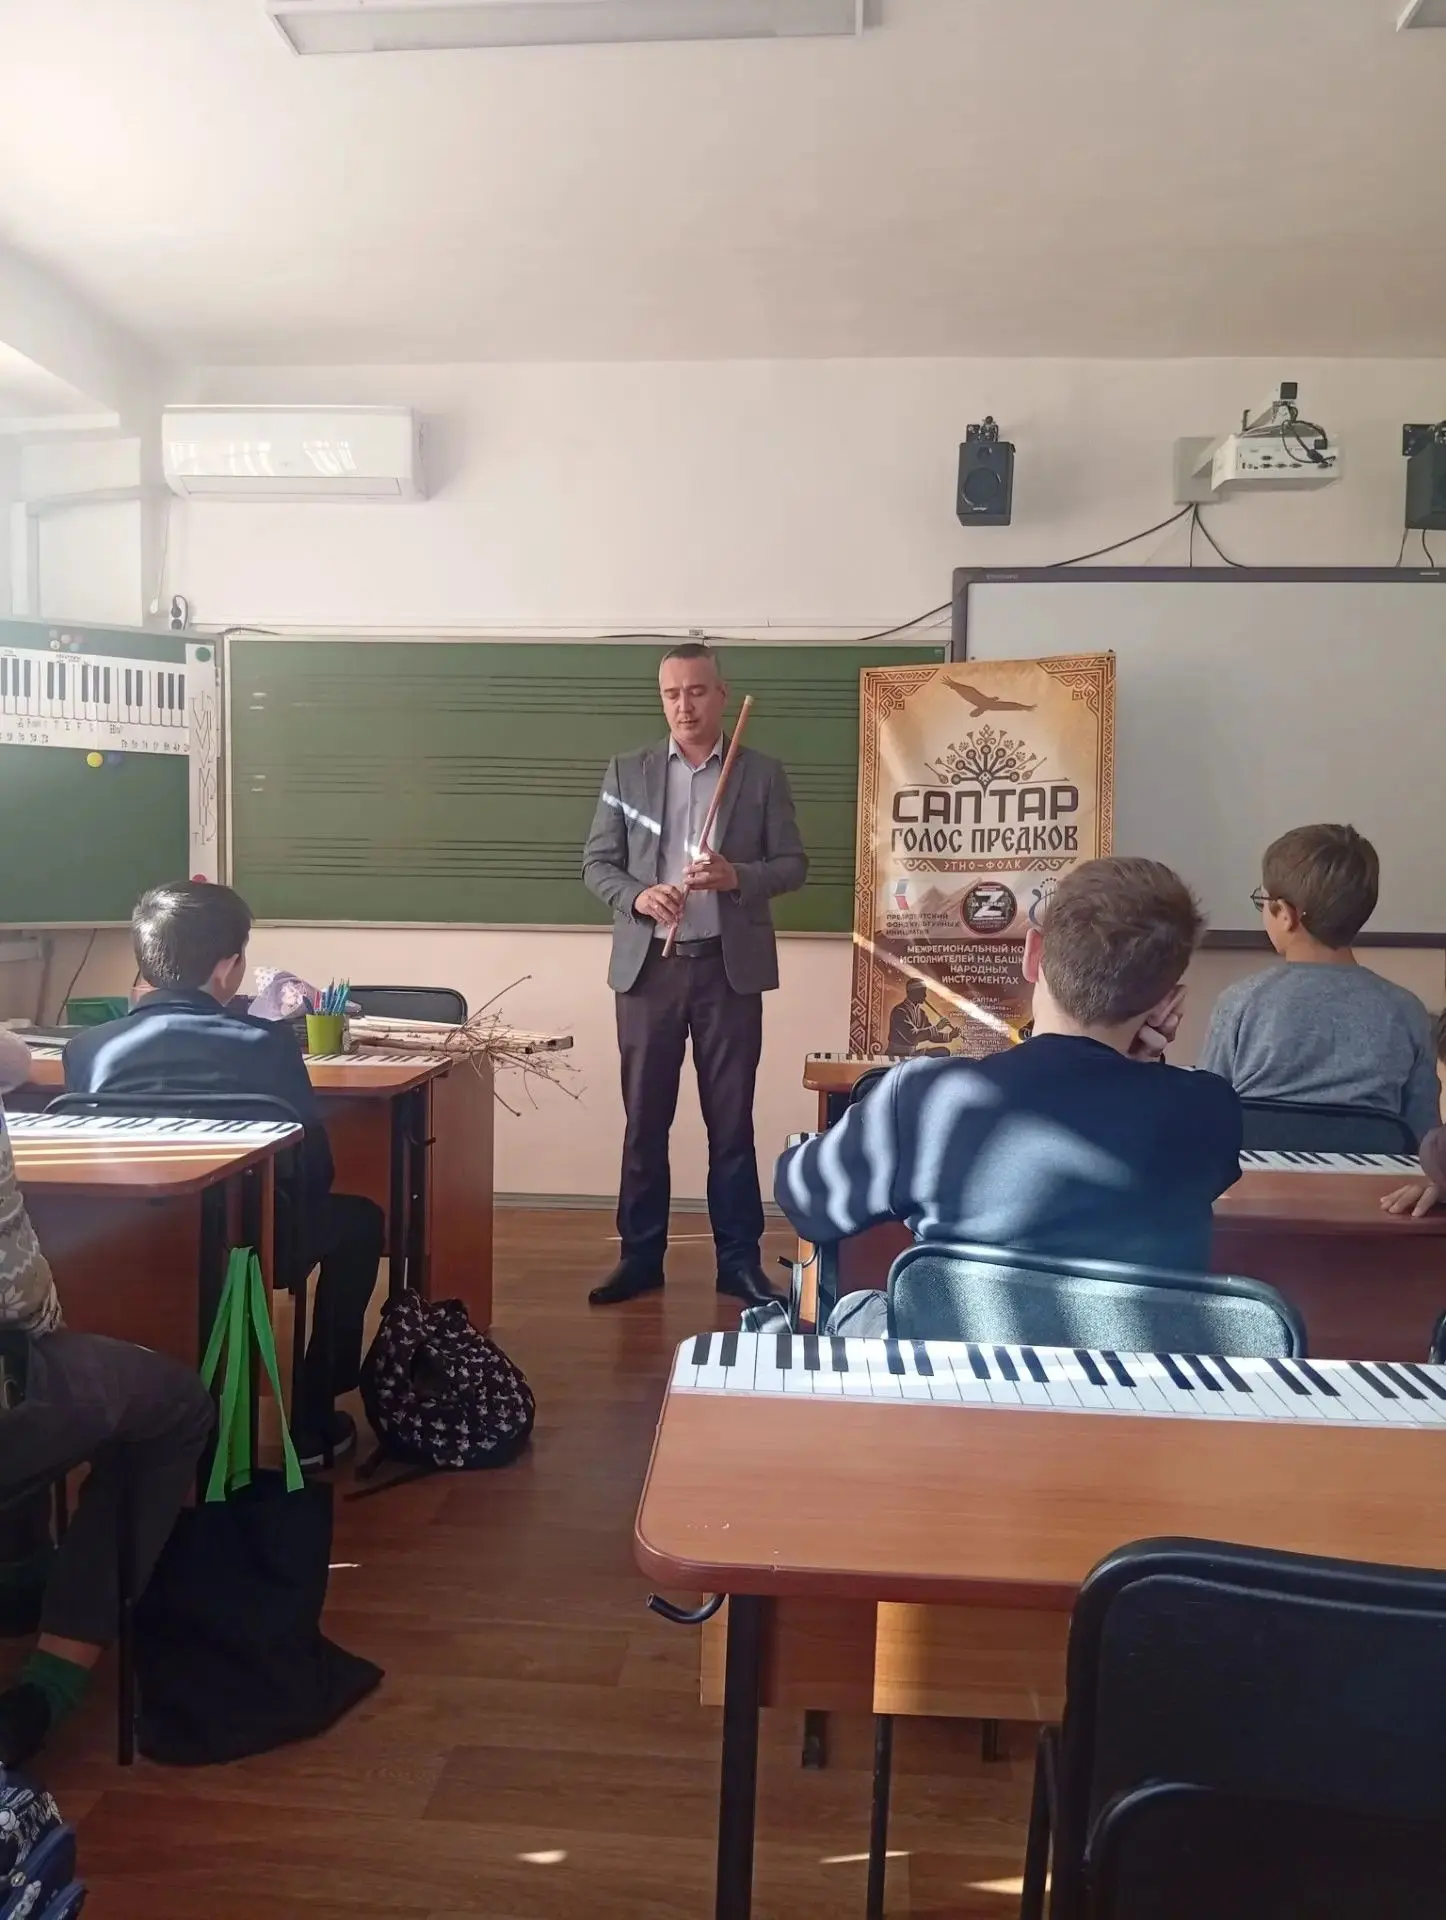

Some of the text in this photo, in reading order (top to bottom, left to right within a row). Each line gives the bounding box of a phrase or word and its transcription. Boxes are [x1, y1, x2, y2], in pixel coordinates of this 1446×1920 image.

[892, 786, 1079, 824] САПТАР
[891, 825, 1078, 854] ГОЛОС ПРЕДКОВ
[943, 860, 1023, 872] ЭТНО-ФОЛК
[886, 912, 949, 920] ПРЕИДТСКИЙ
[907, 943, 1008, 954] МЕЖРЕГИОНАЛЬНЫЙ
[900, 954, 974, 964] ИСПОЛНИТЕЛЕЙ
[977, 955, 992, 964] НА
[950, 965, 1008, 974] НАРОДНЫХ
[941, 975, 1020, 985] ИНСТРУМЕНТАХ
